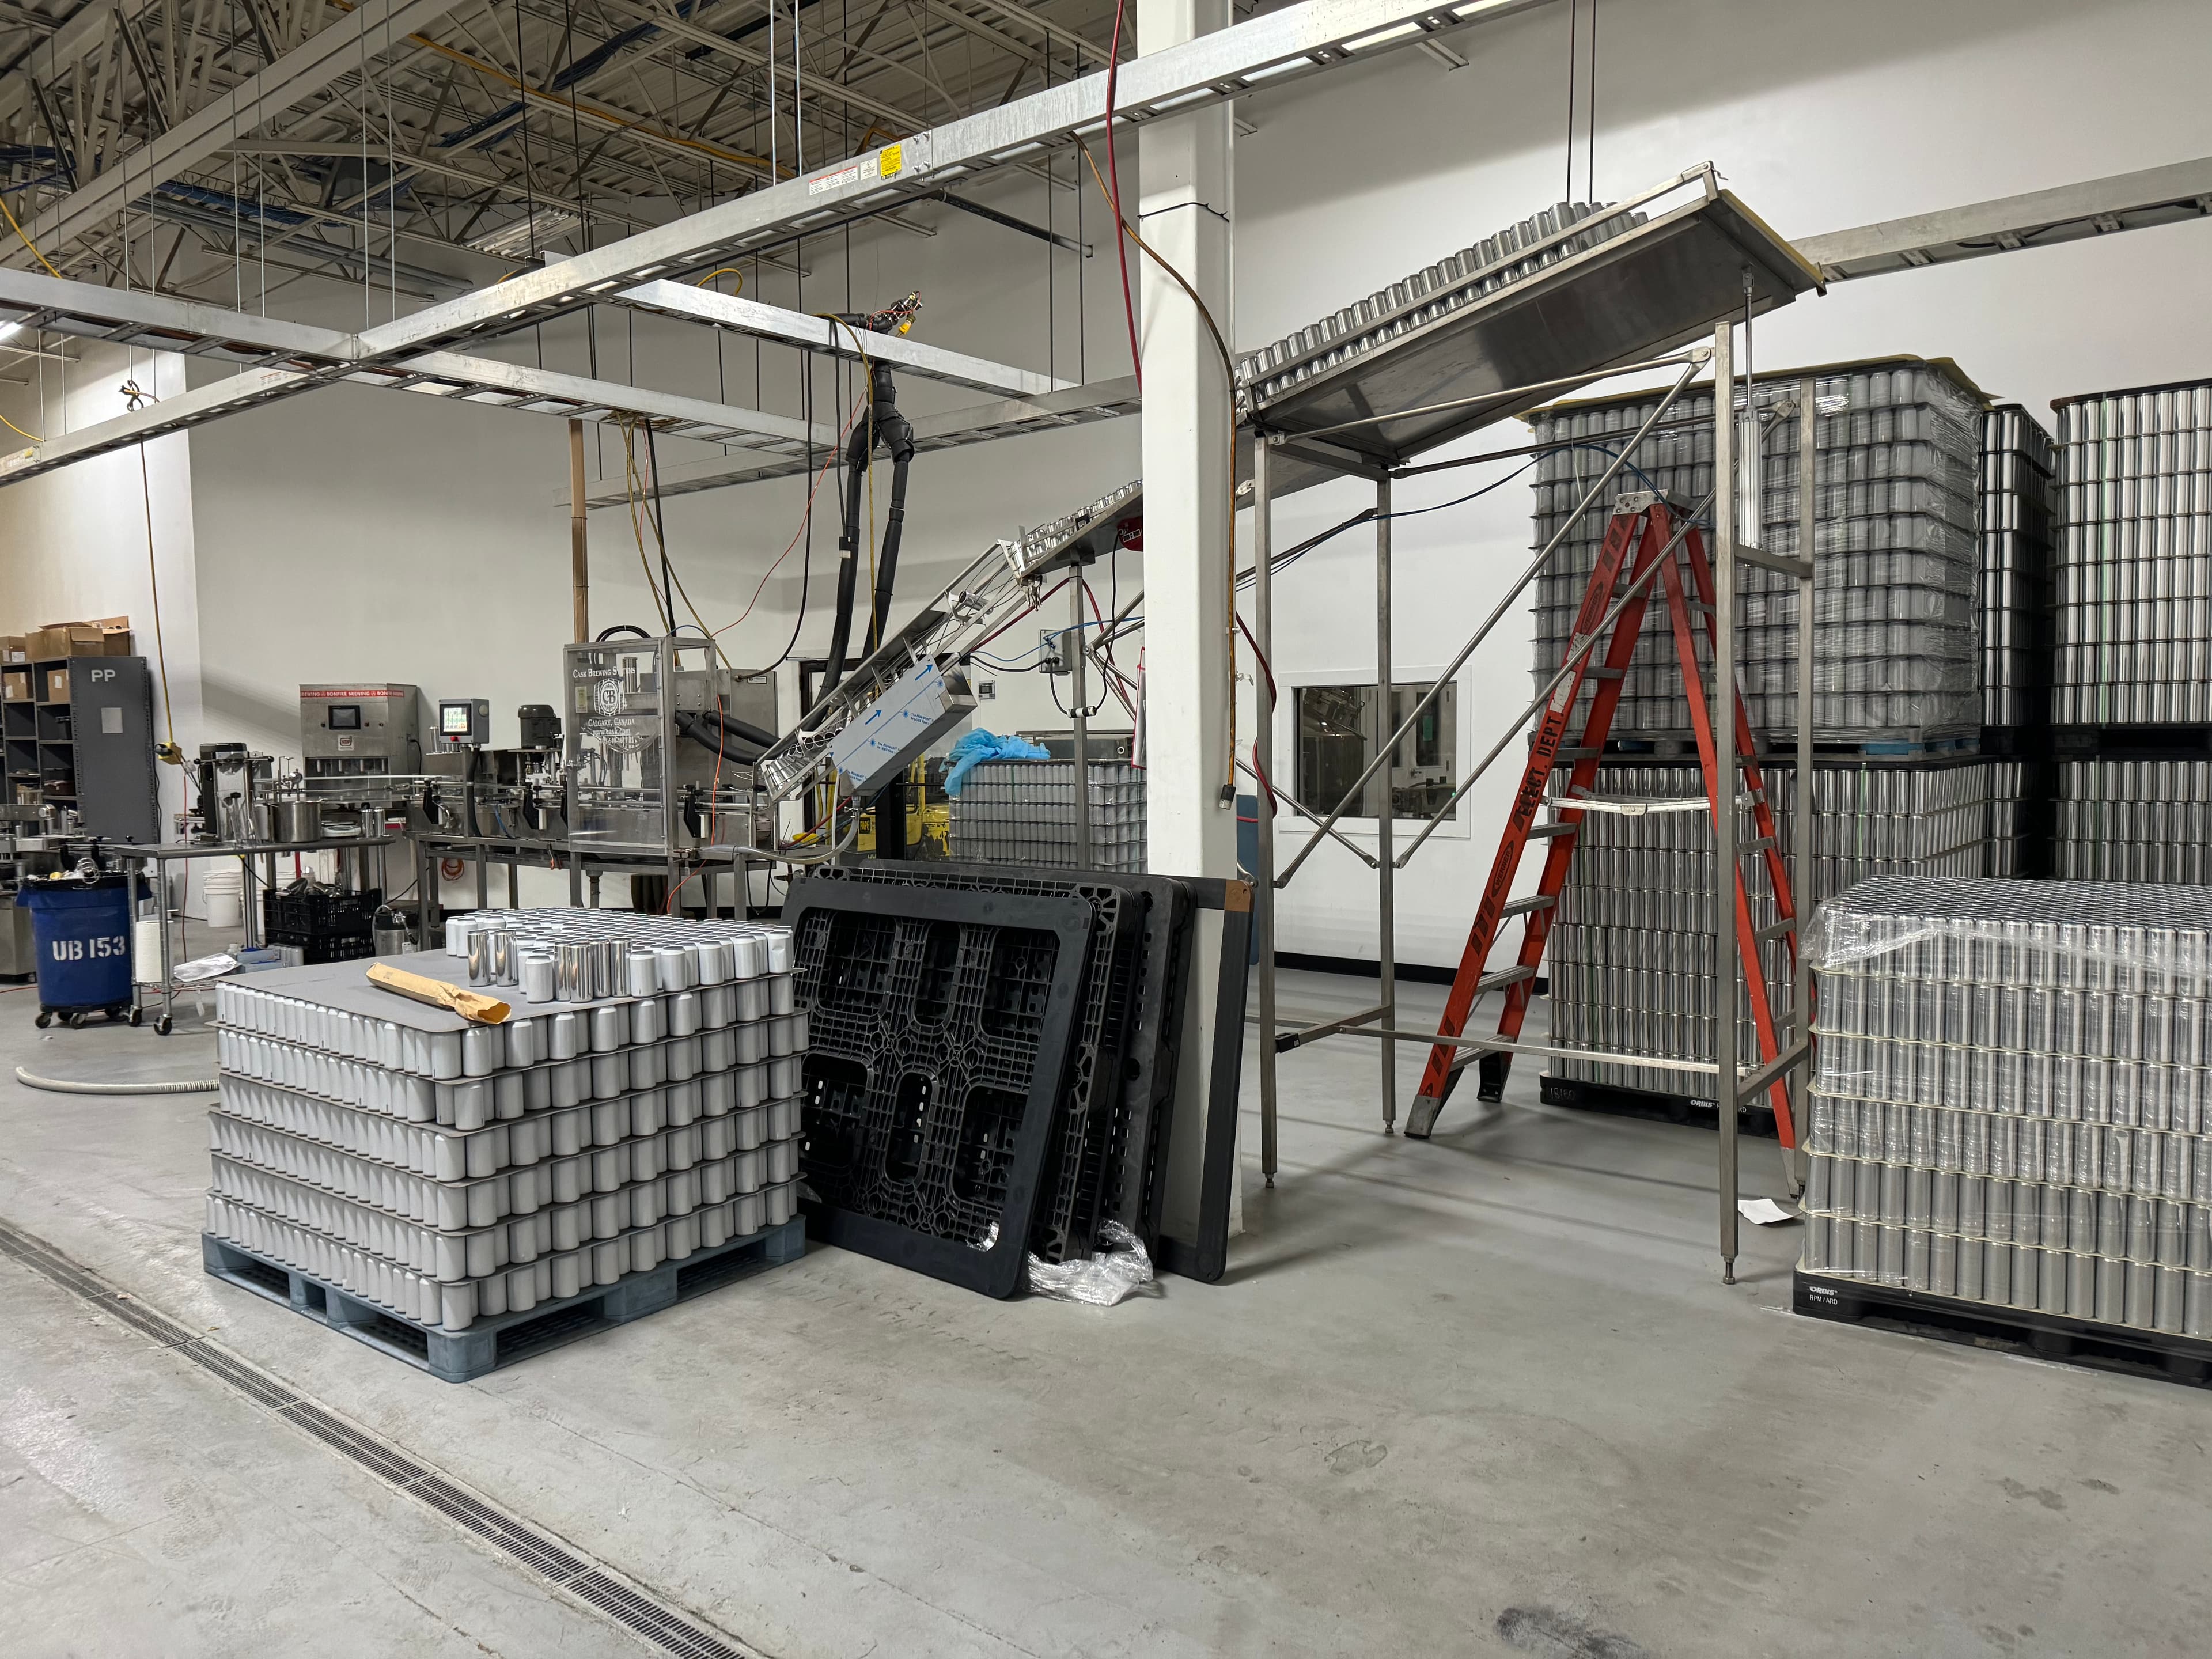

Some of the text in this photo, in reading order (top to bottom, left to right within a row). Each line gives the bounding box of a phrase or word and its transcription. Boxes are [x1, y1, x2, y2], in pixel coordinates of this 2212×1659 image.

[91, 669, 116, 682] PP
[573, 669, 586, 678] CASK
[588, 668, 611, 677] BREWING
[613, 718, 635, 726] CANADA
[1536, 714, 1564, 757] DEPT.
[1495, 850, 1510, 885] WERNER
[52, 936, 126, 961] UB 153
[1809, 1294, 1822, 1302] RPM
